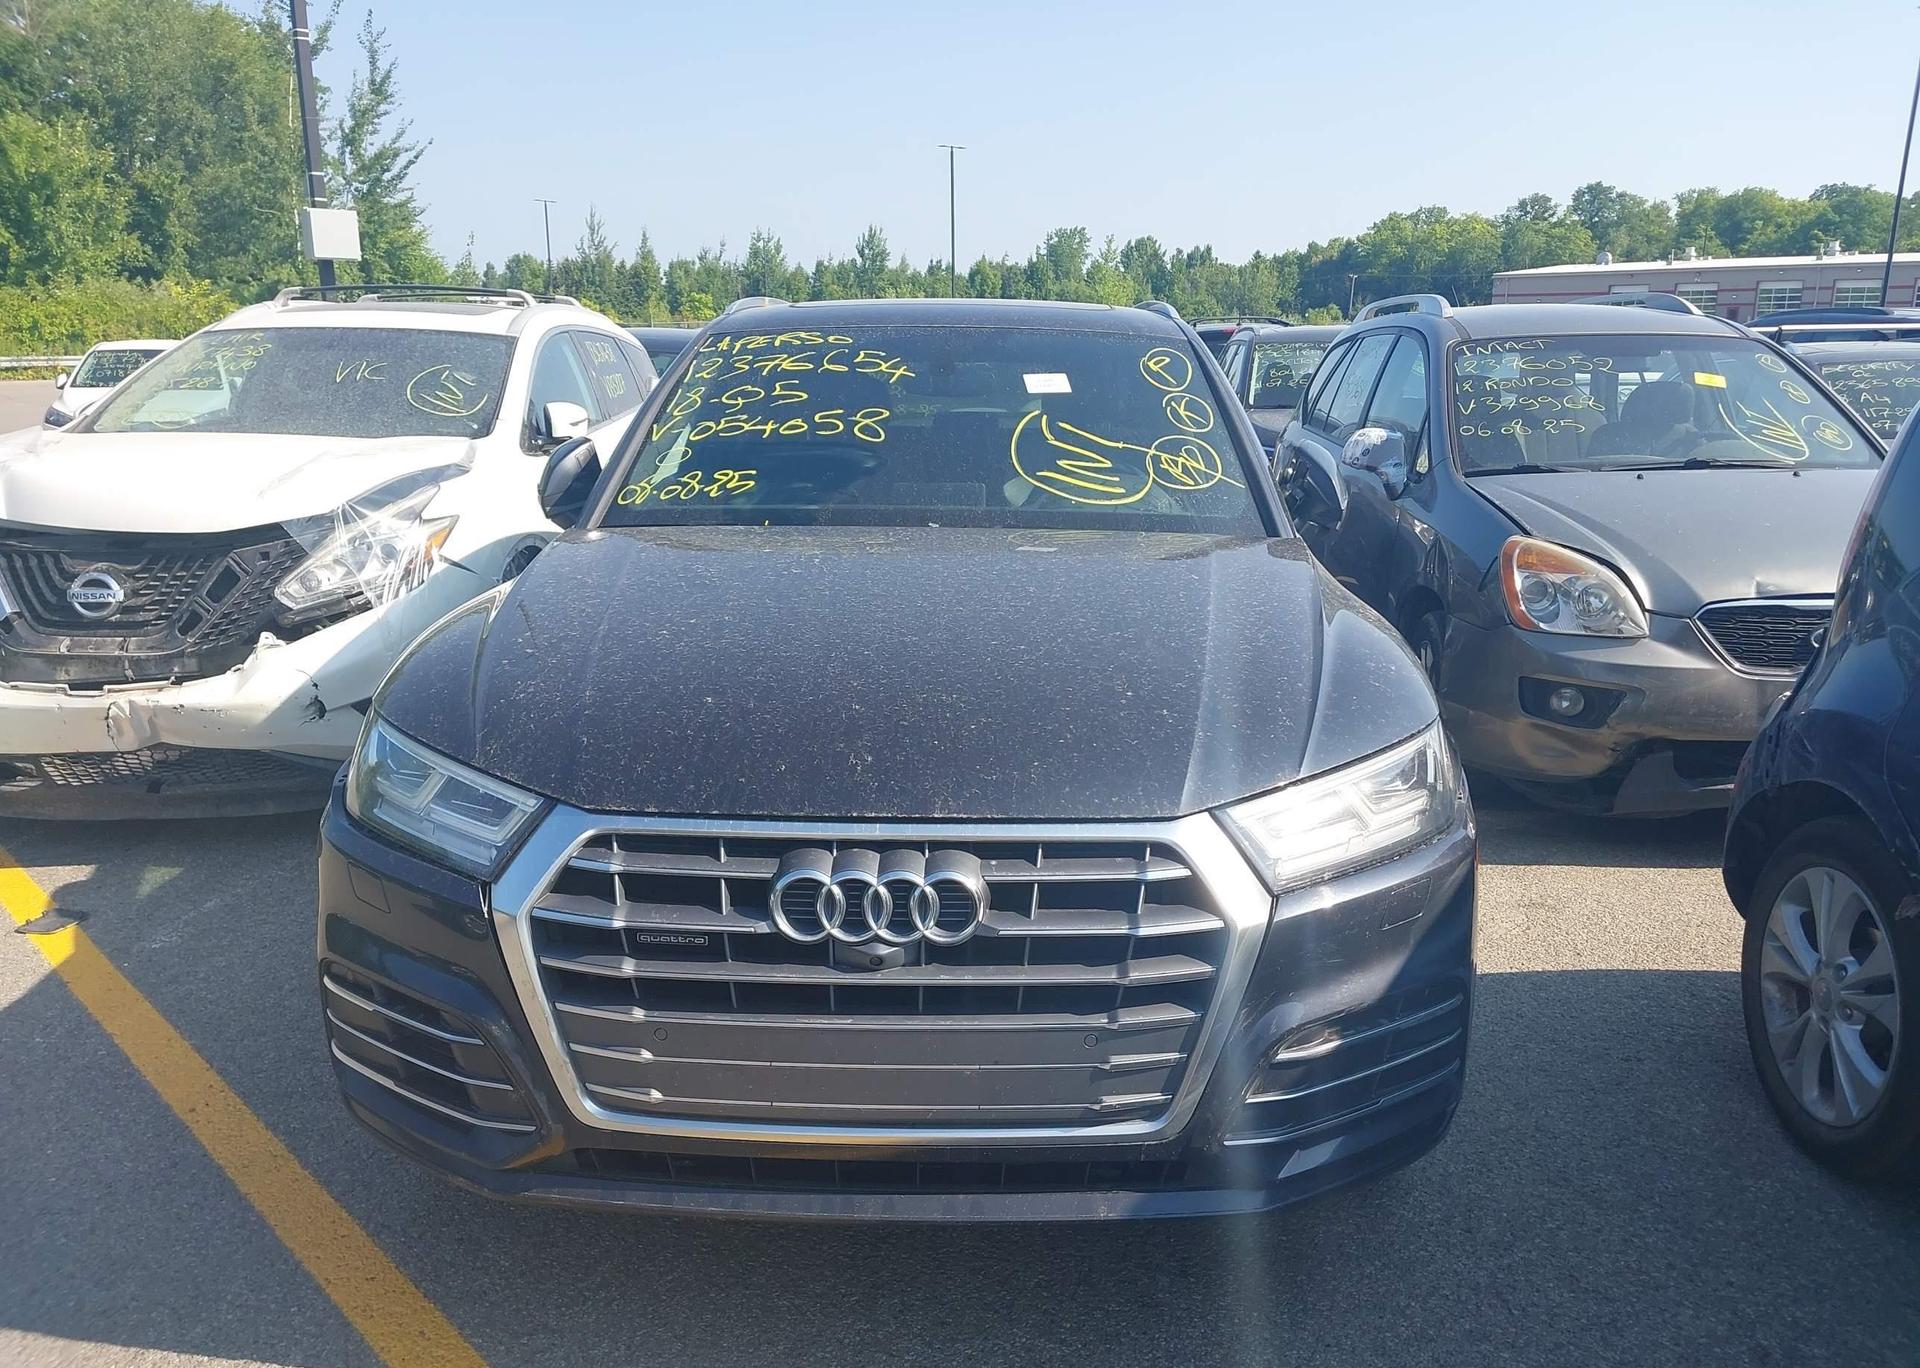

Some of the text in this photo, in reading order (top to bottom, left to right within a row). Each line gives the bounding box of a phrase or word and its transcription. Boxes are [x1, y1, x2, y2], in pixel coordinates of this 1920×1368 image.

[1456, 339, 1555, 358] INTACT
[71, 592, 116, 601] NISSAN
[639, 934, 706, 944] quattro
